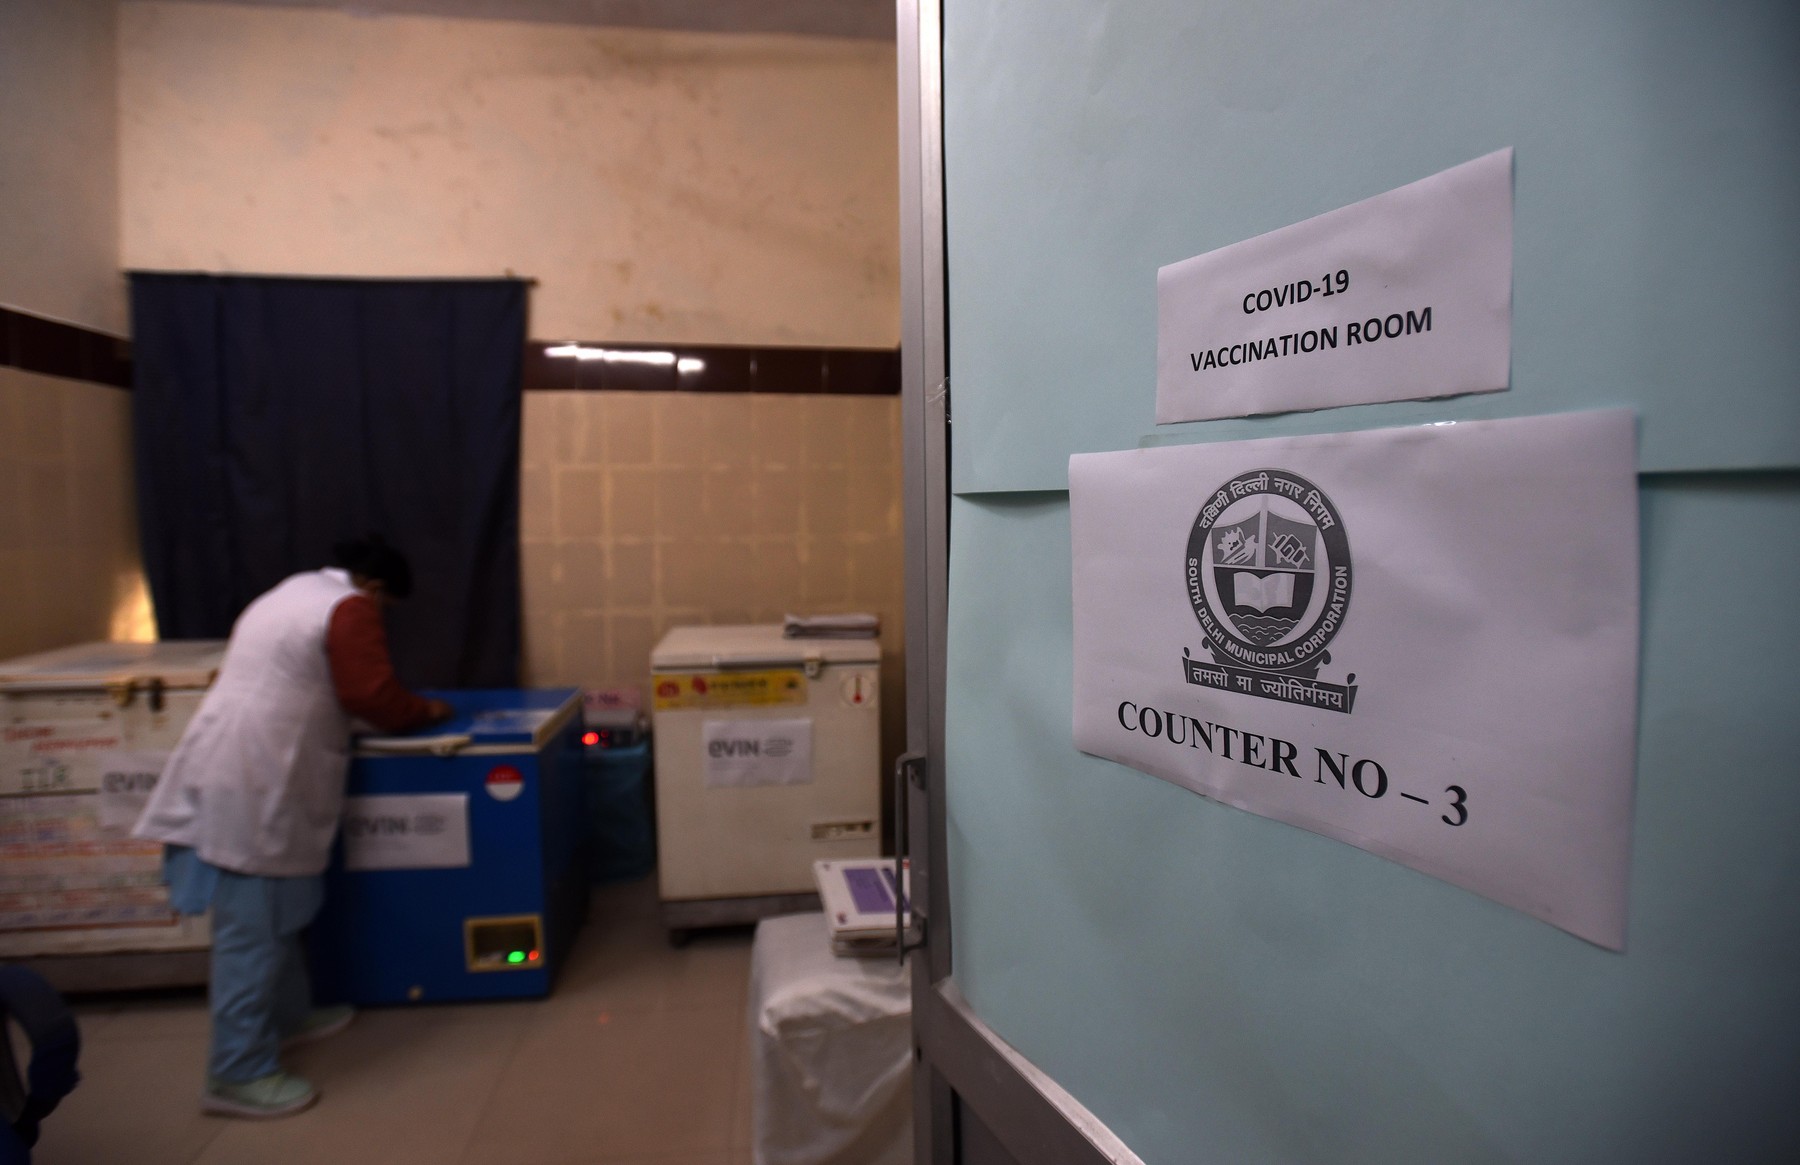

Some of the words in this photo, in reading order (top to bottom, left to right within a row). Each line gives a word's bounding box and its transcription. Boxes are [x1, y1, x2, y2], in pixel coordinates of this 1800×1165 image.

[1243, 269, 1349, 315] COVID-19
[1190, 326, 1338, 372] VACCINATION
[1346, 307, 1432, 346] ROOM
[1199, 491, 1230, 530] दक्षिणी
[1229, 472, 1269, 497] दिल्ली
[1273, 477, 1305, 500] नगर
[1303, 489, 1335, 531] निगम
[1187, 557, 1202, 605] SOUTH
[1197, 607, 1225, 644] DELHI
[1225, 639, 1295, 666] MUNICIPAL
[1296, 565, 1348, 660] CORPORATION
[1192, 666, 1229, 688] तमसो
[1236, 675, 1253, 692] मा
[1118, 700, 1301, 778] COUNTER
[1314, 747, 1388, 800] NO
[1441, 785, 1469, 827] 3
